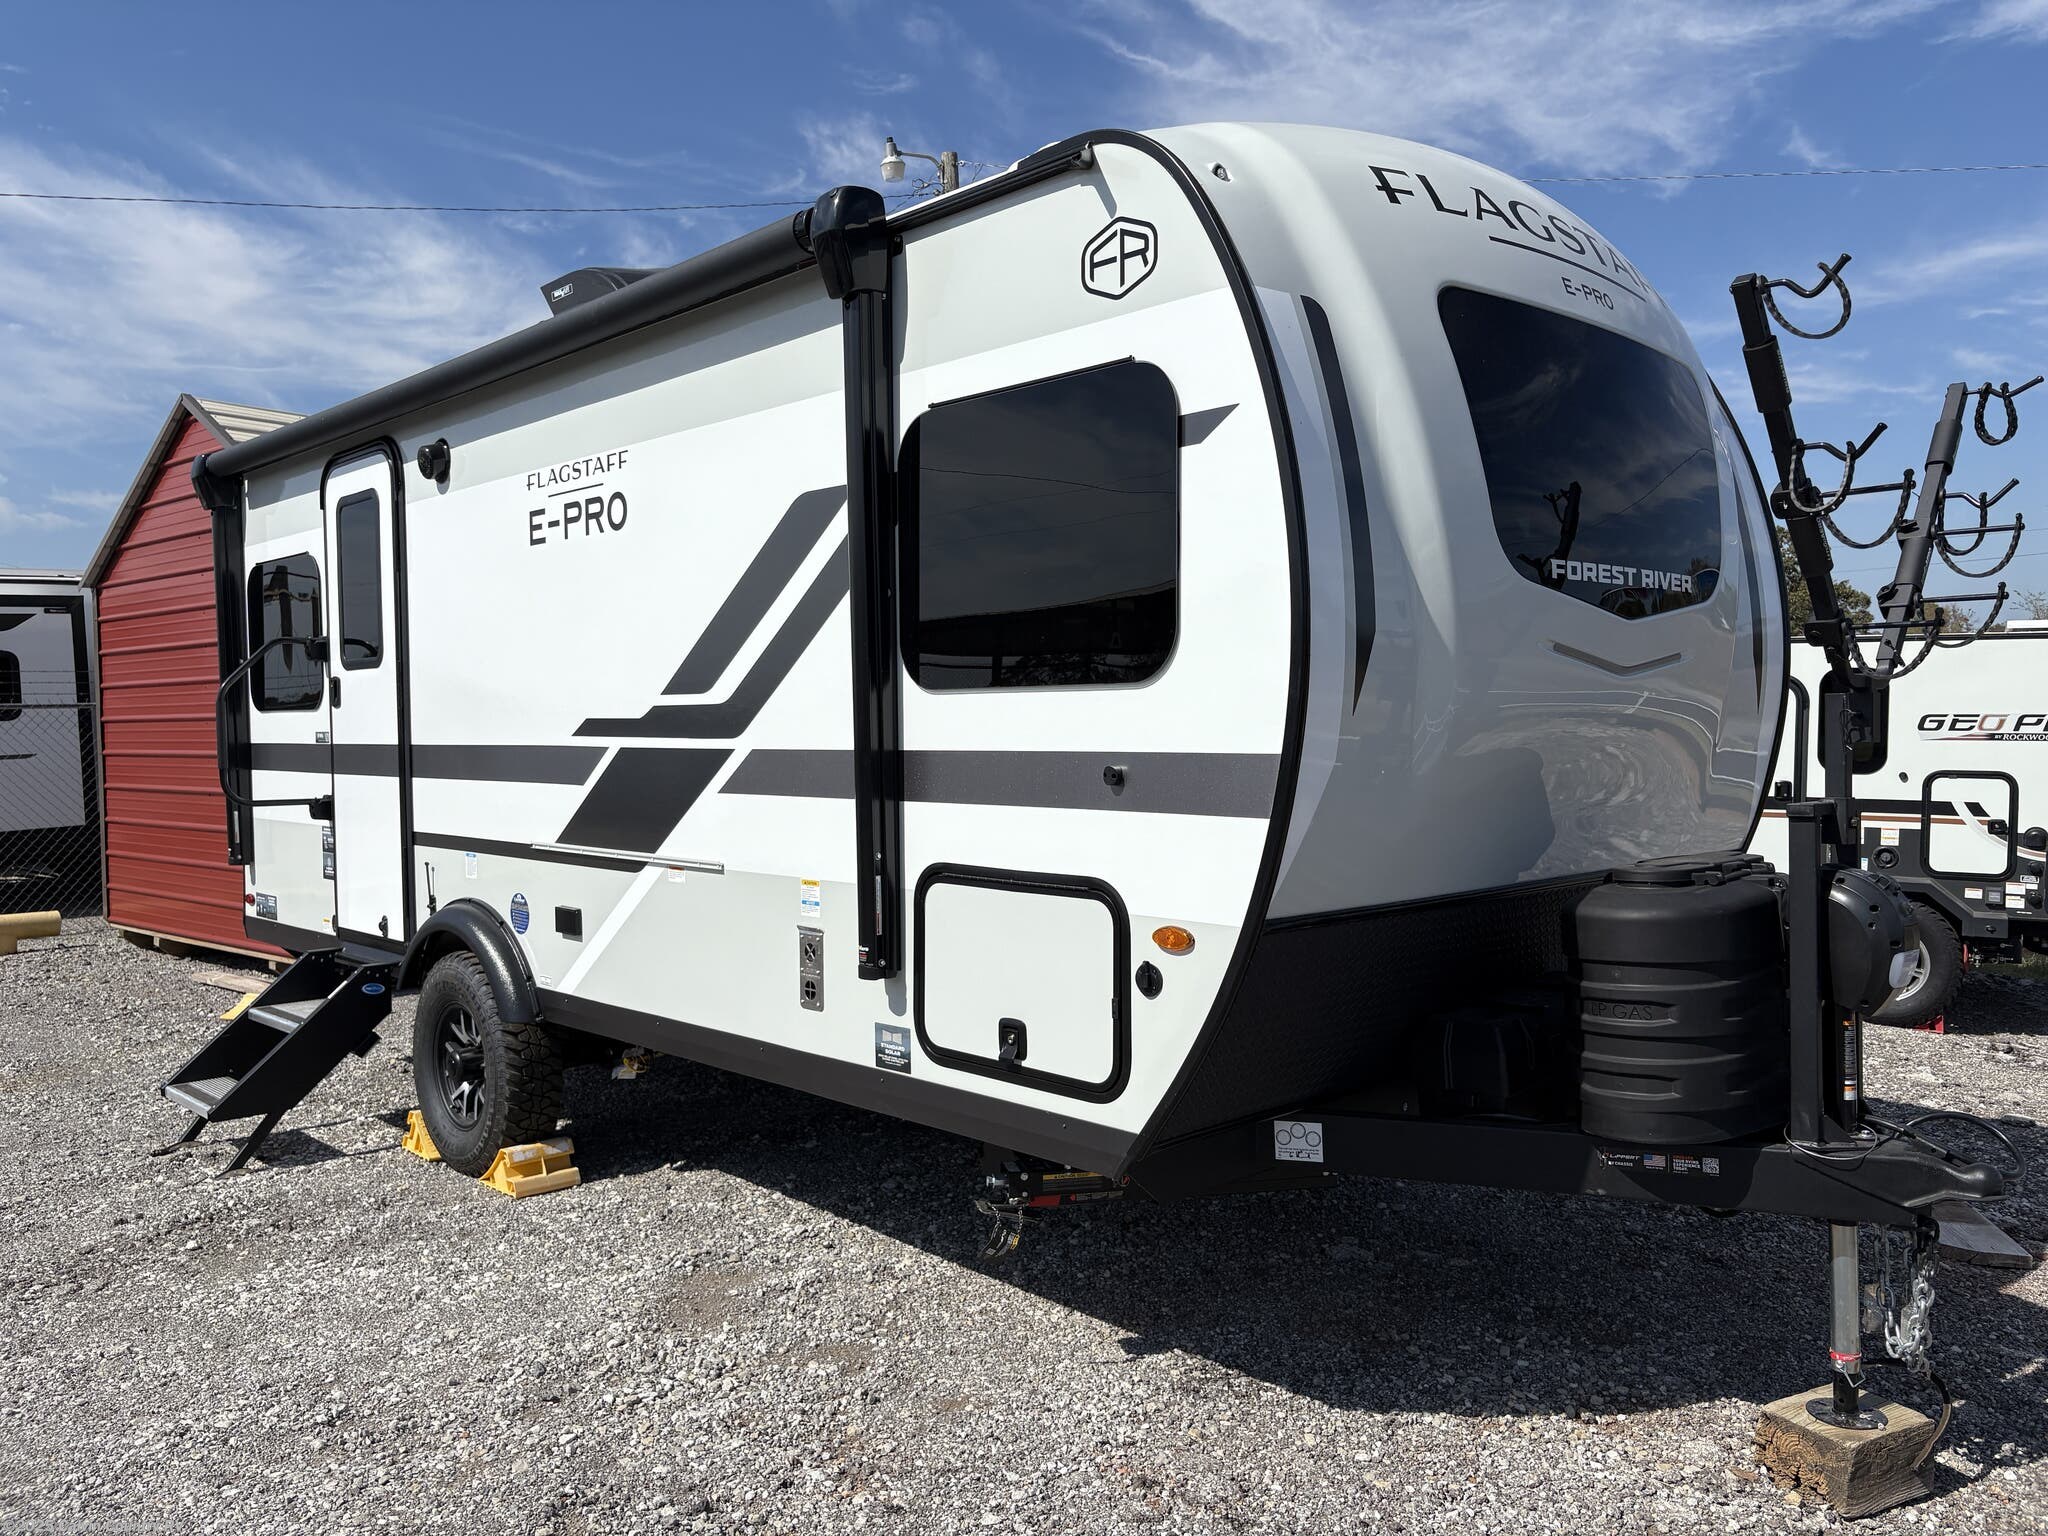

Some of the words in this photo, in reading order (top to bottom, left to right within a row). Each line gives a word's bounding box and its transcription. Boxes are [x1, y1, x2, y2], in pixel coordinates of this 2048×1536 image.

[1561, 276, 1614, 310] E-PRO
[526, 449, 629, 491] FLAGSTAFF
[529, 491, 628, 546] E-PRO
[1550, 559, 1636, 586] FOREST
[1640, 569, 1692, 593] RIVER
[1917, 714, 2010, 731] GEO
[1612, 1004, 1653, 1021] GAS
